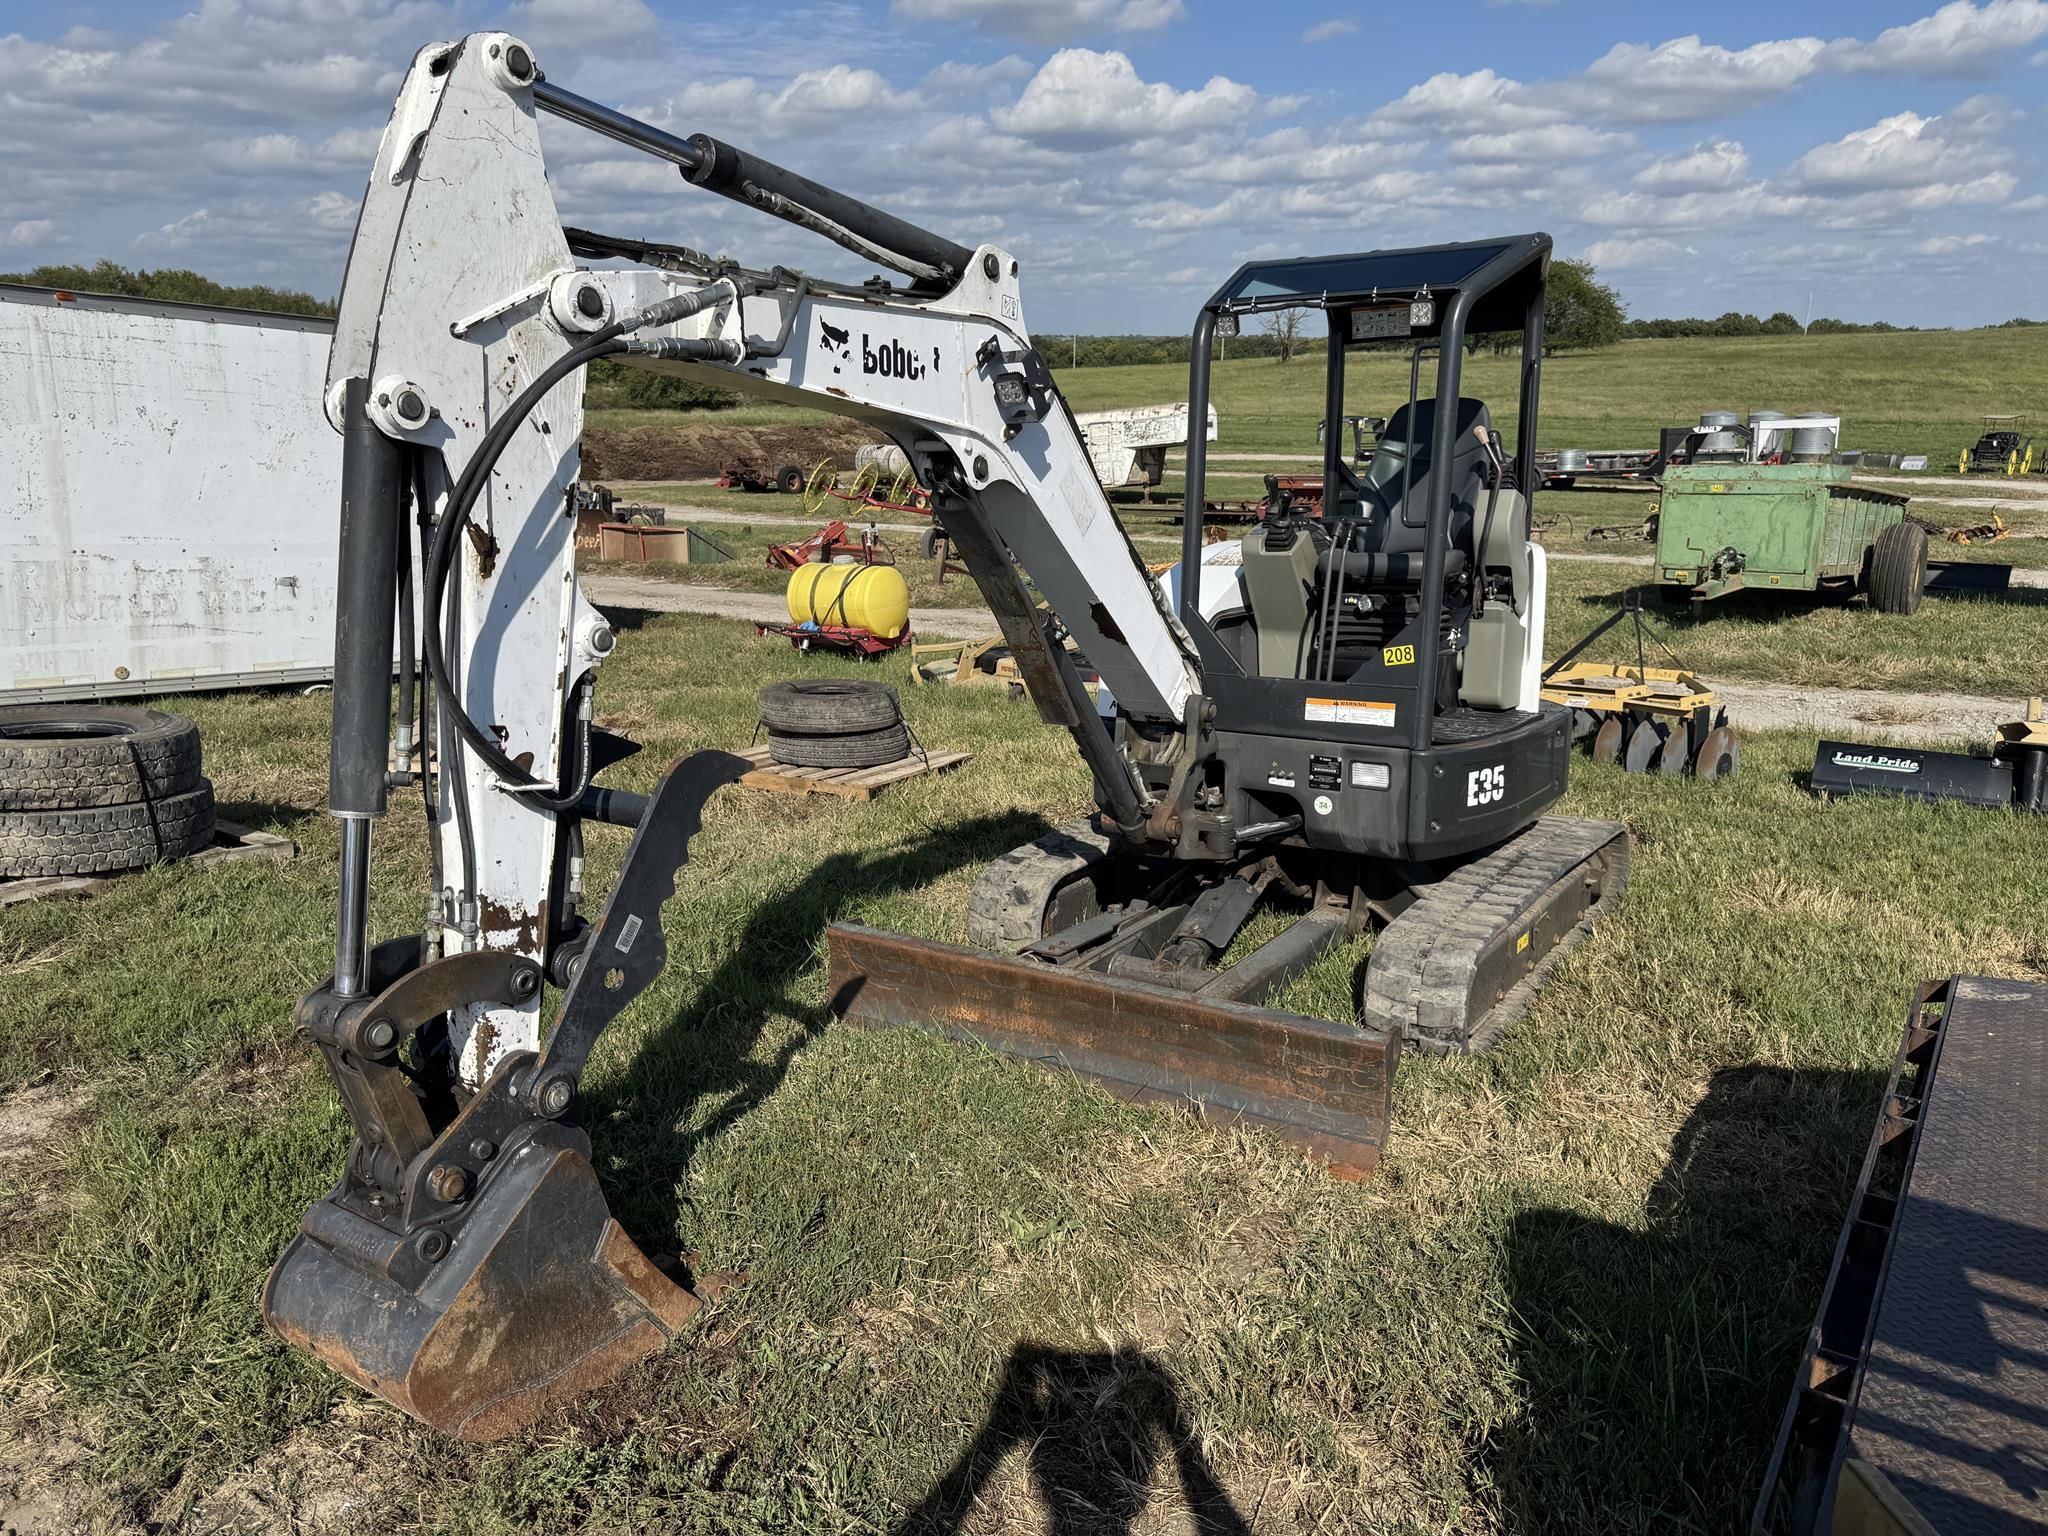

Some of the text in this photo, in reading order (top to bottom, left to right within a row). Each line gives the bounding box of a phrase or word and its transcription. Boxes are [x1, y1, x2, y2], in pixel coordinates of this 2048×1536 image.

[1385, 646, 1413, 663] 208
[1834, 751, 1919, 769] Land Pride
[1467, 764, 1504, 807] E35
